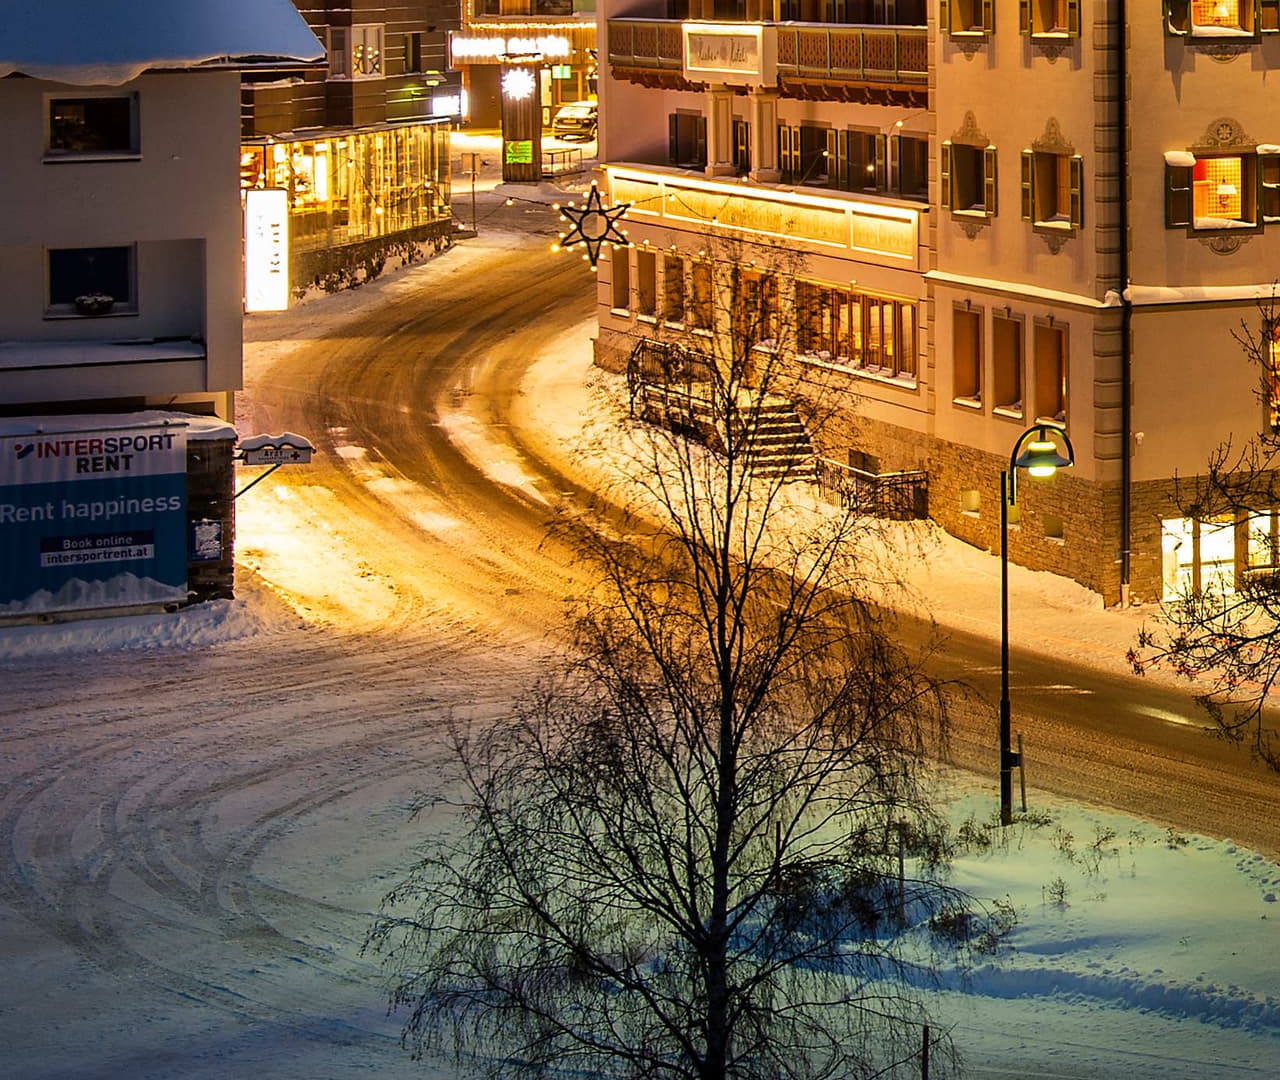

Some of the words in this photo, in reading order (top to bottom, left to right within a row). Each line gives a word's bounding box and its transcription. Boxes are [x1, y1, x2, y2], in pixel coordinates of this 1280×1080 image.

[37, 433, 176, 458] INTERSPORT
[76, 454, 134, 473] RENT
[0, 502, 54, 523] Rent
[62, 495, 182, 521] happiness
[63, 538, 92, 549] Book
[96, 535, 133, 546] online
[47, 546, 149, 564] intersportrent.at
